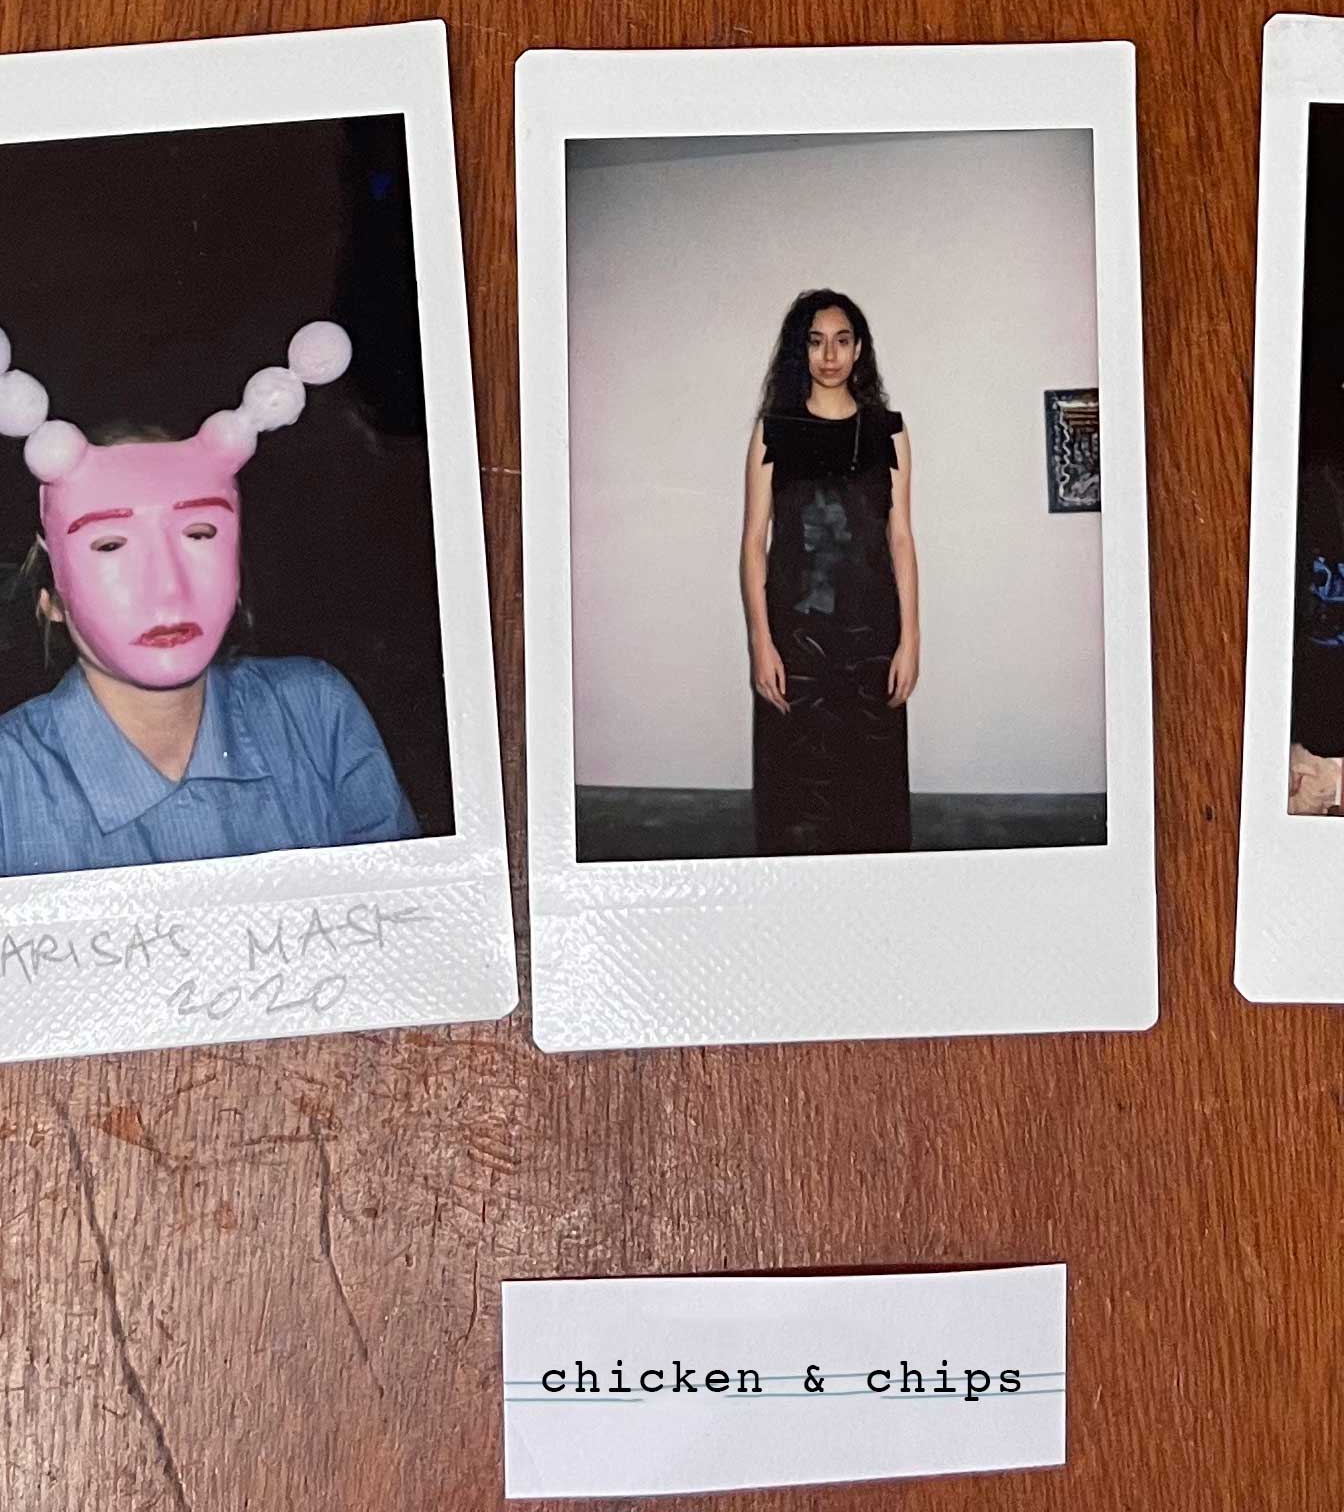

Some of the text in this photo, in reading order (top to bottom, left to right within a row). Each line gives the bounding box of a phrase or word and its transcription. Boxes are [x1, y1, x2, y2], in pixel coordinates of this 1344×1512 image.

[244, 903, 433, 970] MASK
[167, 973, 349, 1021] 2020
[541, 1360, 1023, 1401] chicken & chips
